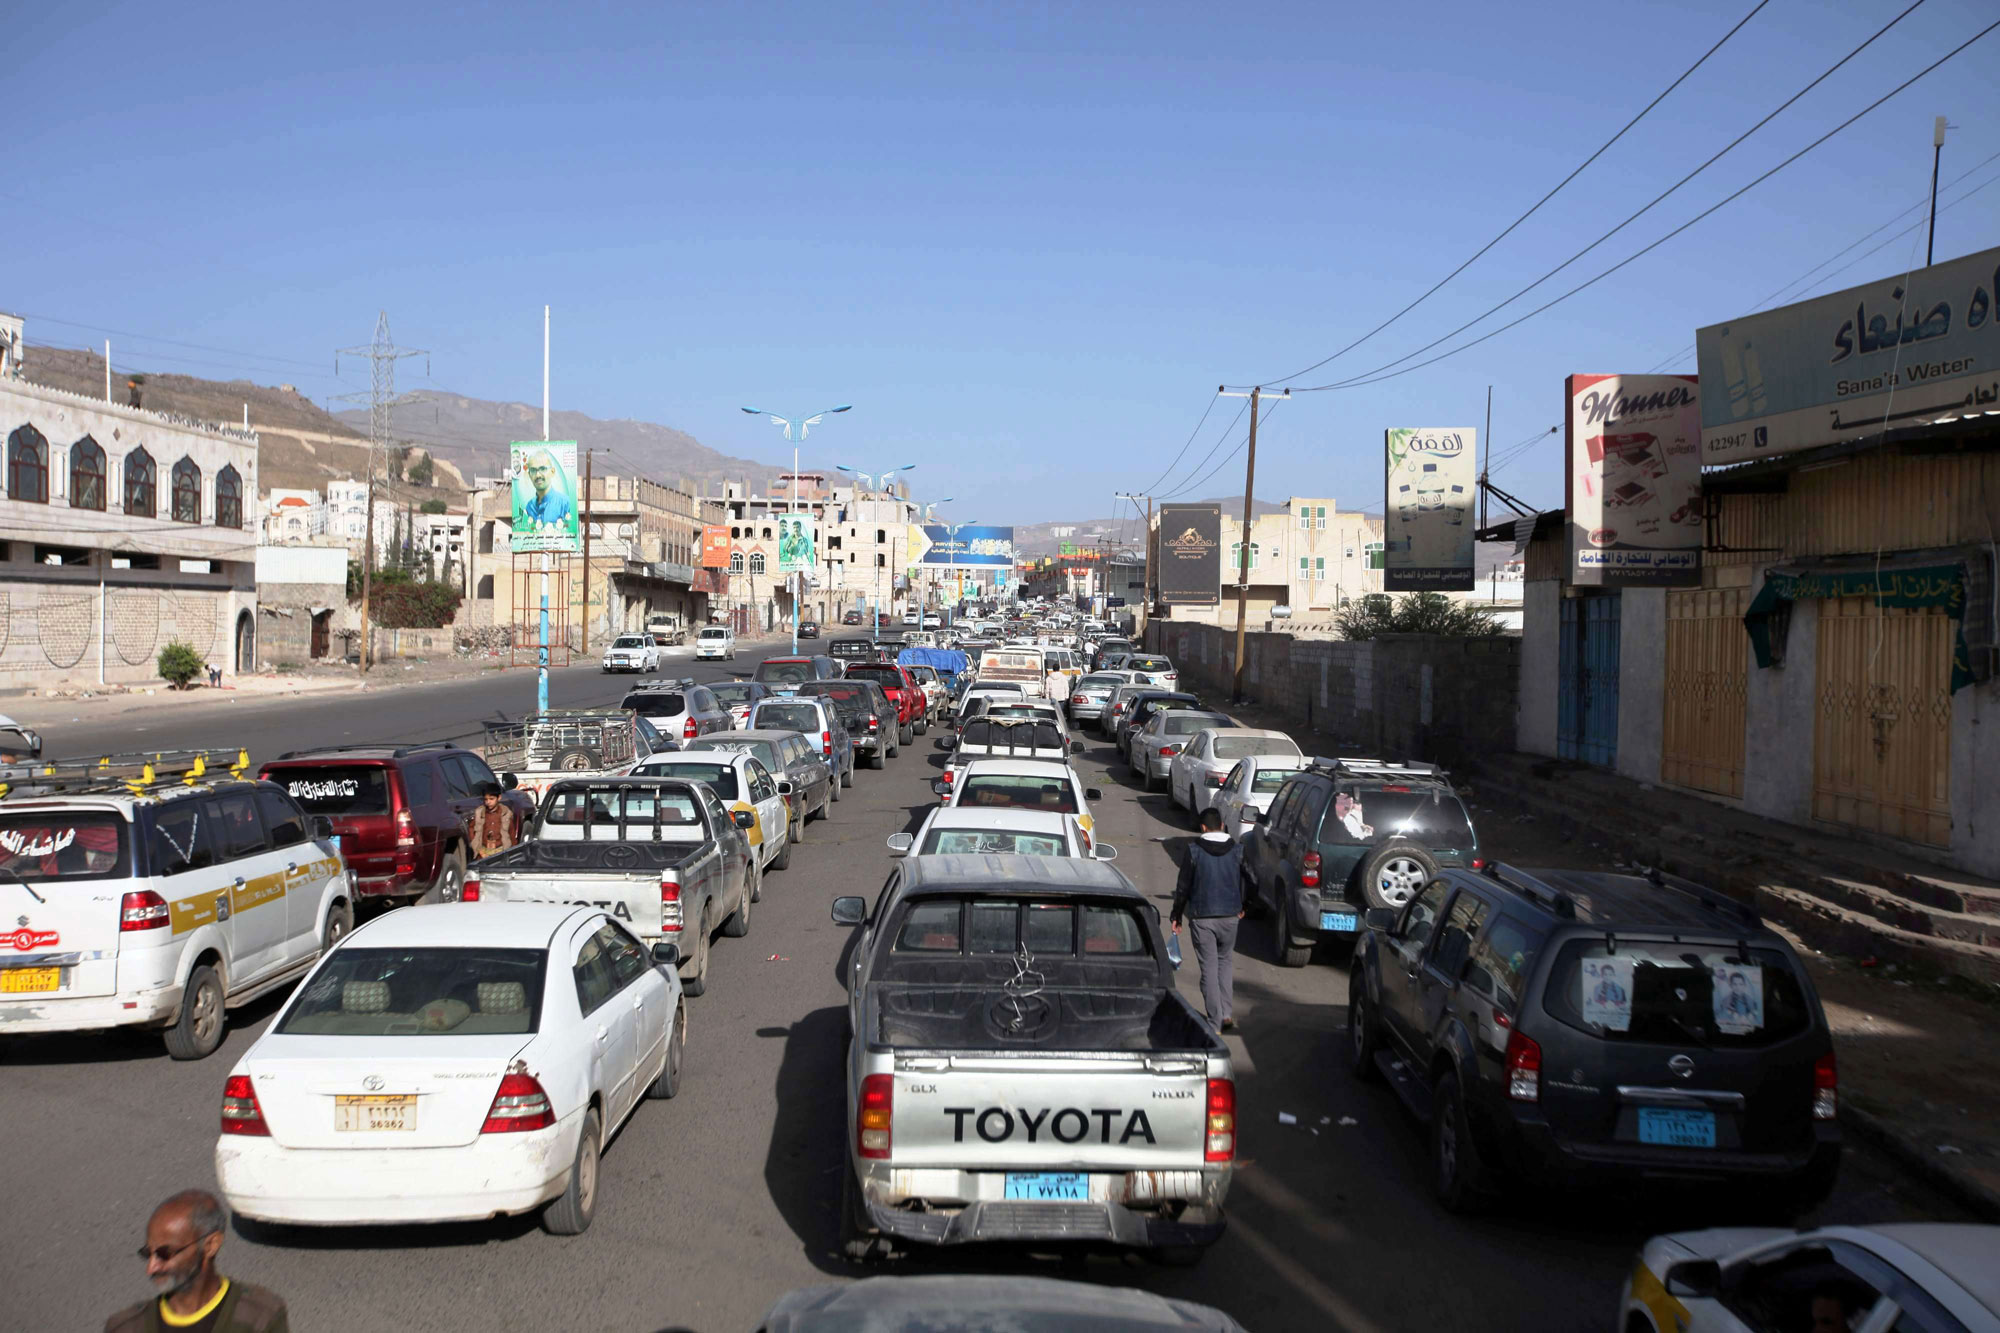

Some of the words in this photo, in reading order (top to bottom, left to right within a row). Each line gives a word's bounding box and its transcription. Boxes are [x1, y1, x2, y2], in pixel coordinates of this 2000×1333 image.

[1831, 285, 1951, 363] صنعاء
[1837, 371, 1899, 396] Sana'a
[1906, 357, 1975, 382] Water
[1581, 385, 1697, 427] Manner
[1830, 381, 2000, 431] لعامة
[1410, 432, 1464, 452] القمة
[1708, 433, 1747, 452] 422947
[1580, 550, 1615, 564] العامة
[1615, 551, 1652, 566] للتجارة
[1653, 551, 1695, 567] الوصابي
[911, 1084, 938, 1094] GLX
[369, 1119, 405, 1129] 36362
[943, 1107, 1157, 1144] TOYOTA
[1038, 1185, 1079, 1199] ٧٧٩١٨
